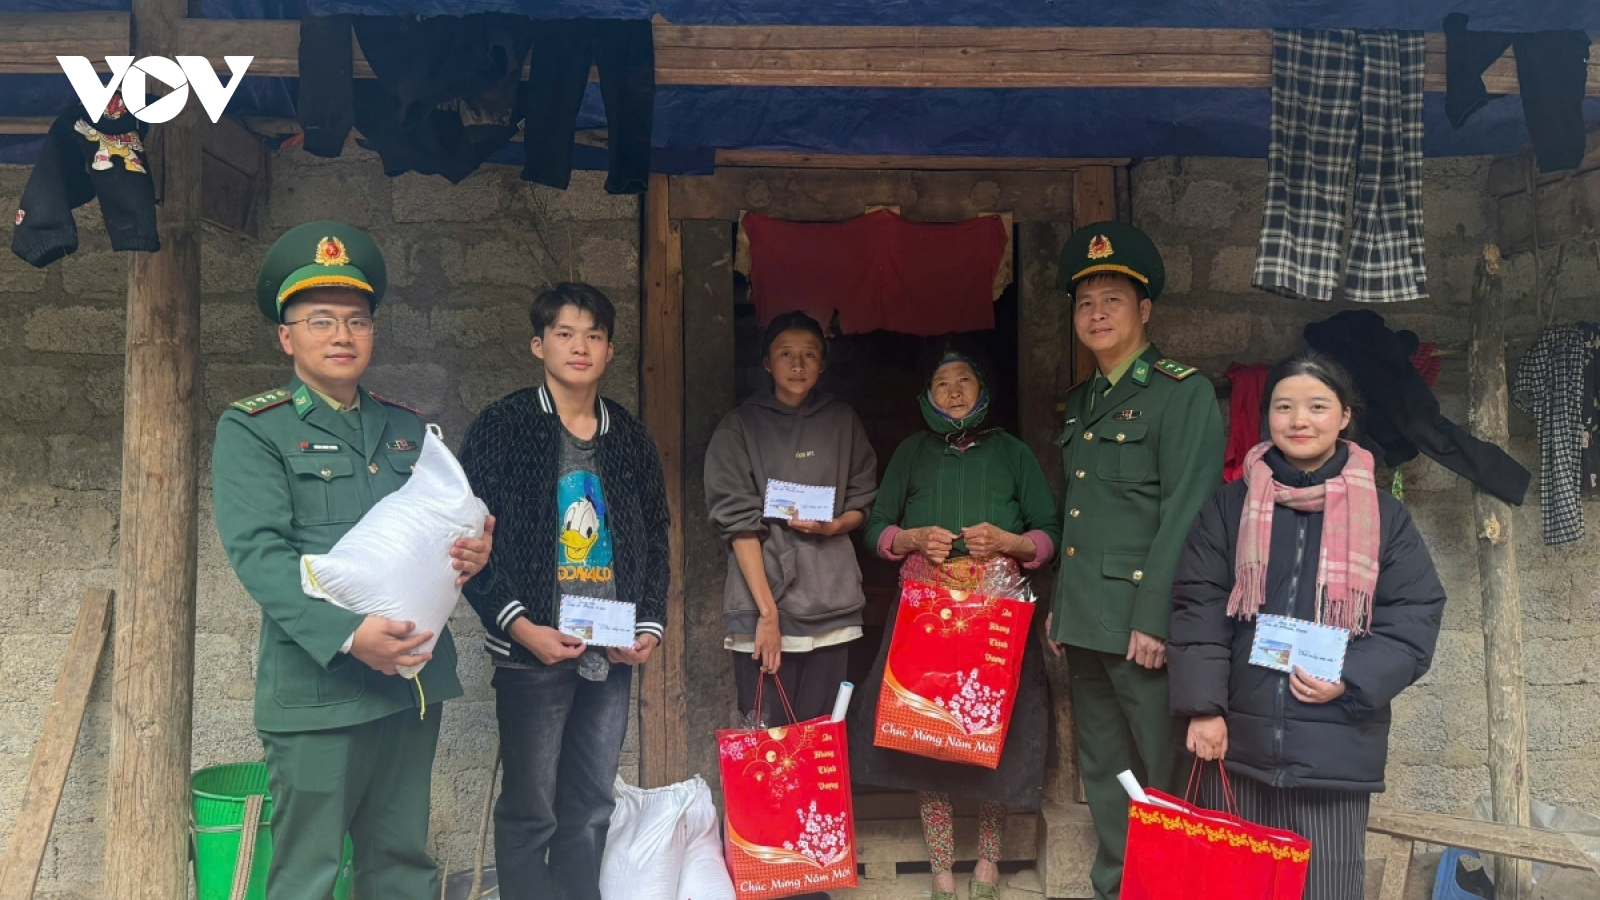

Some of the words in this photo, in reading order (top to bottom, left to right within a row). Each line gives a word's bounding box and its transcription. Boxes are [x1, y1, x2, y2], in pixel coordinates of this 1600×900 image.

[558, 566, 613, 583] DONALD
[881, 722, 909, 738] Chúc
[911, 729, 942, 746] Mừng
[945, 735, 972, 749] Năm
[974, 741, 996, 754] Mới
[740, 880, 767, 892] Chúc
[771, 878, 801, 890] Mừng
[804, 873, 829, 886] Năm
